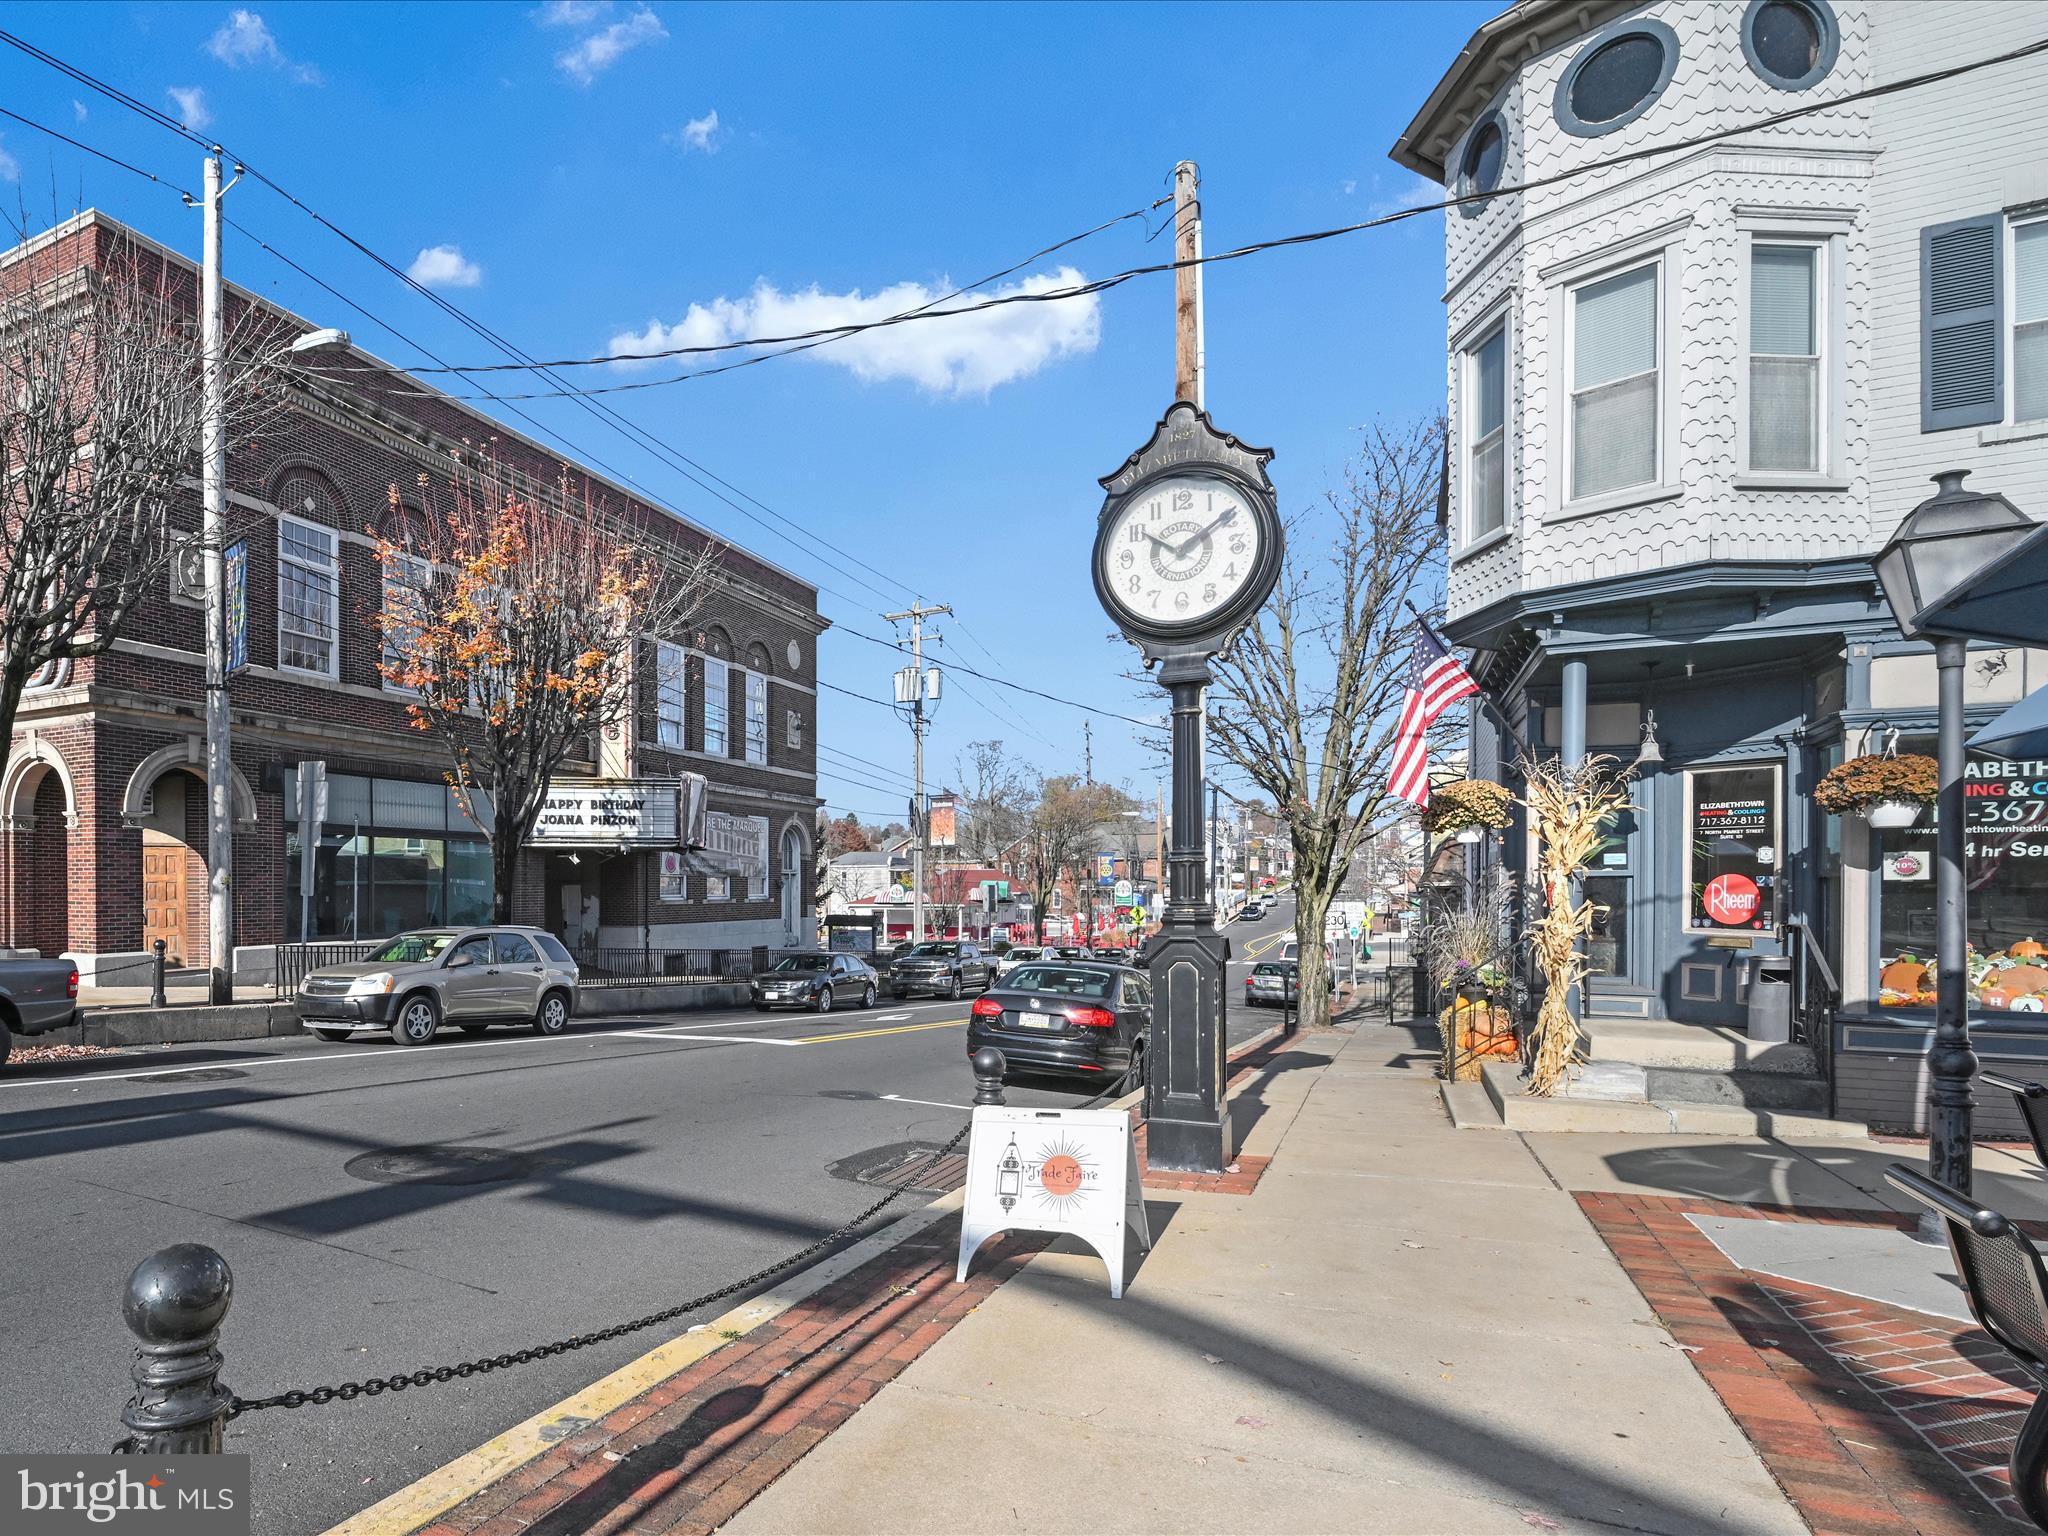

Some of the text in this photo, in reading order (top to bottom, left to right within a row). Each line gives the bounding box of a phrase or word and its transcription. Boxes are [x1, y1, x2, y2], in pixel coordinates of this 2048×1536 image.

[1172, 490, 1194, 512] 12
[1207, 493, 1212, 512] 1
[1150, 502, 1161, 520] 11
[1129, 524, 1146, 542] 10
[1162, 522, 1201, 539] ROTARY
[1229, 532, 1246, 554] 3
[1120, 549, 1134, 569] 9
[1151, 550, 1212, 580] INTERNATIONAL
[1222, 561, 1238, 581] 4
[1129, 574, 1141, 594] 8
[1203, 583, 1217, 603] 5
[1147, 589, 1161, 609] 7
[1175, 591, 1189, 612] 6
[2007, 781, 2030, 797] &
[590, 800, 646, 810] BIRTHDAY
[1700, 800, 1765, 810] ELIZABETHTOWN
[539, 815, 636, 825] JOANA PINZON
[718, 818, 731, 830] THE
[1700, 816, 1765, 826] 717-367-8112
[1981, 845, 2003, 857] hr
[1711, 874, 1756, 916] Rheem
[1325, 915, 1345, 926] 230
[1025, 1163, 1062, 1182] Trade
